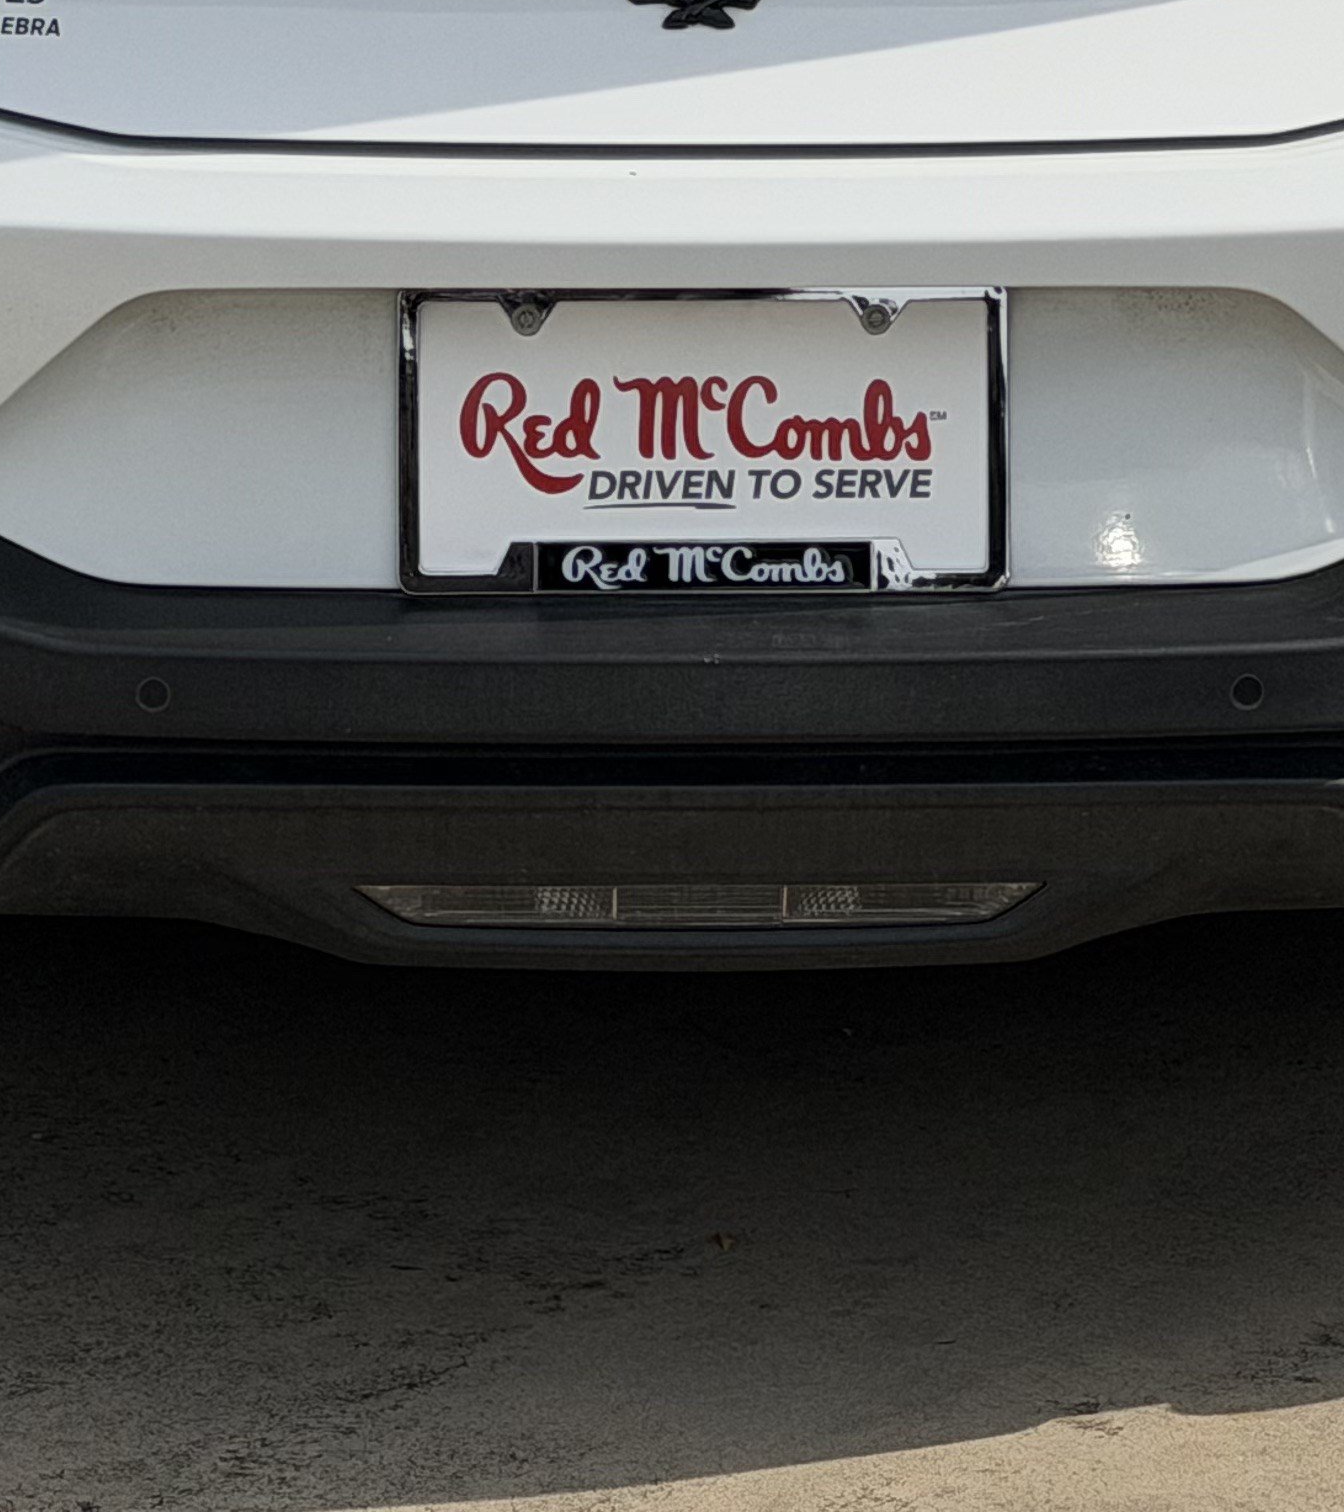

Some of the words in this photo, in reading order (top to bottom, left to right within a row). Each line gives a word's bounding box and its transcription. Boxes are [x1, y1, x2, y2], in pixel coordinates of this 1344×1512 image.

[459, 372, 602, 495] Red
[612, 374, 932, 461] McCombs
[587, 469, 736, 500] DRIVEN
[747, 468, 802, 500] TO
[811, 468, 933, 500] SERVE
[561, 545, 648, 590] Red
[652, 546, 845, 583] McCombs
